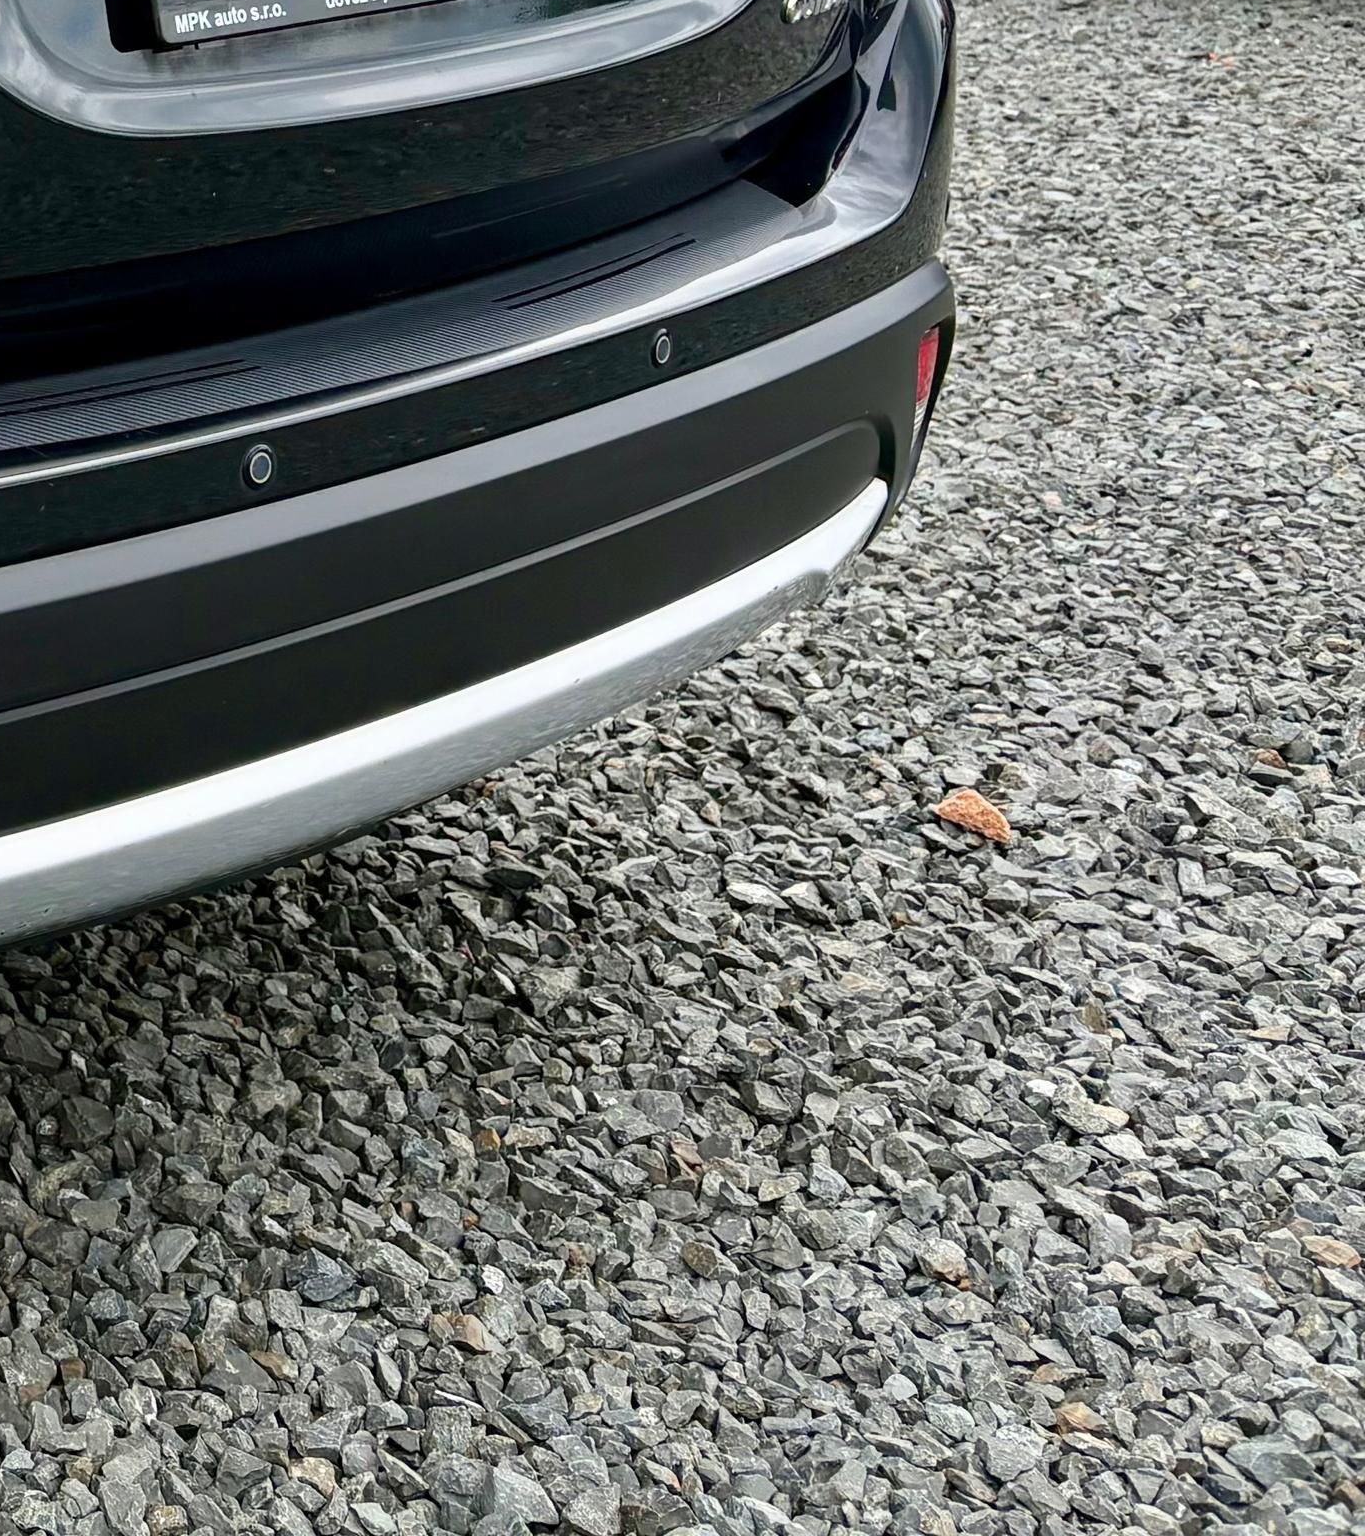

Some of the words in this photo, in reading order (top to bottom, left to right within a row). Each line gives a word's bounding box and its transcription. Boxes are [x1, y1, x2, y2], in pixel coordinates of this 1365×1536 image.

[174, 10, 212, 33] MPK
[214, 7, 247, 27] auto
[250, 3, 287, 21] s.r.o.
